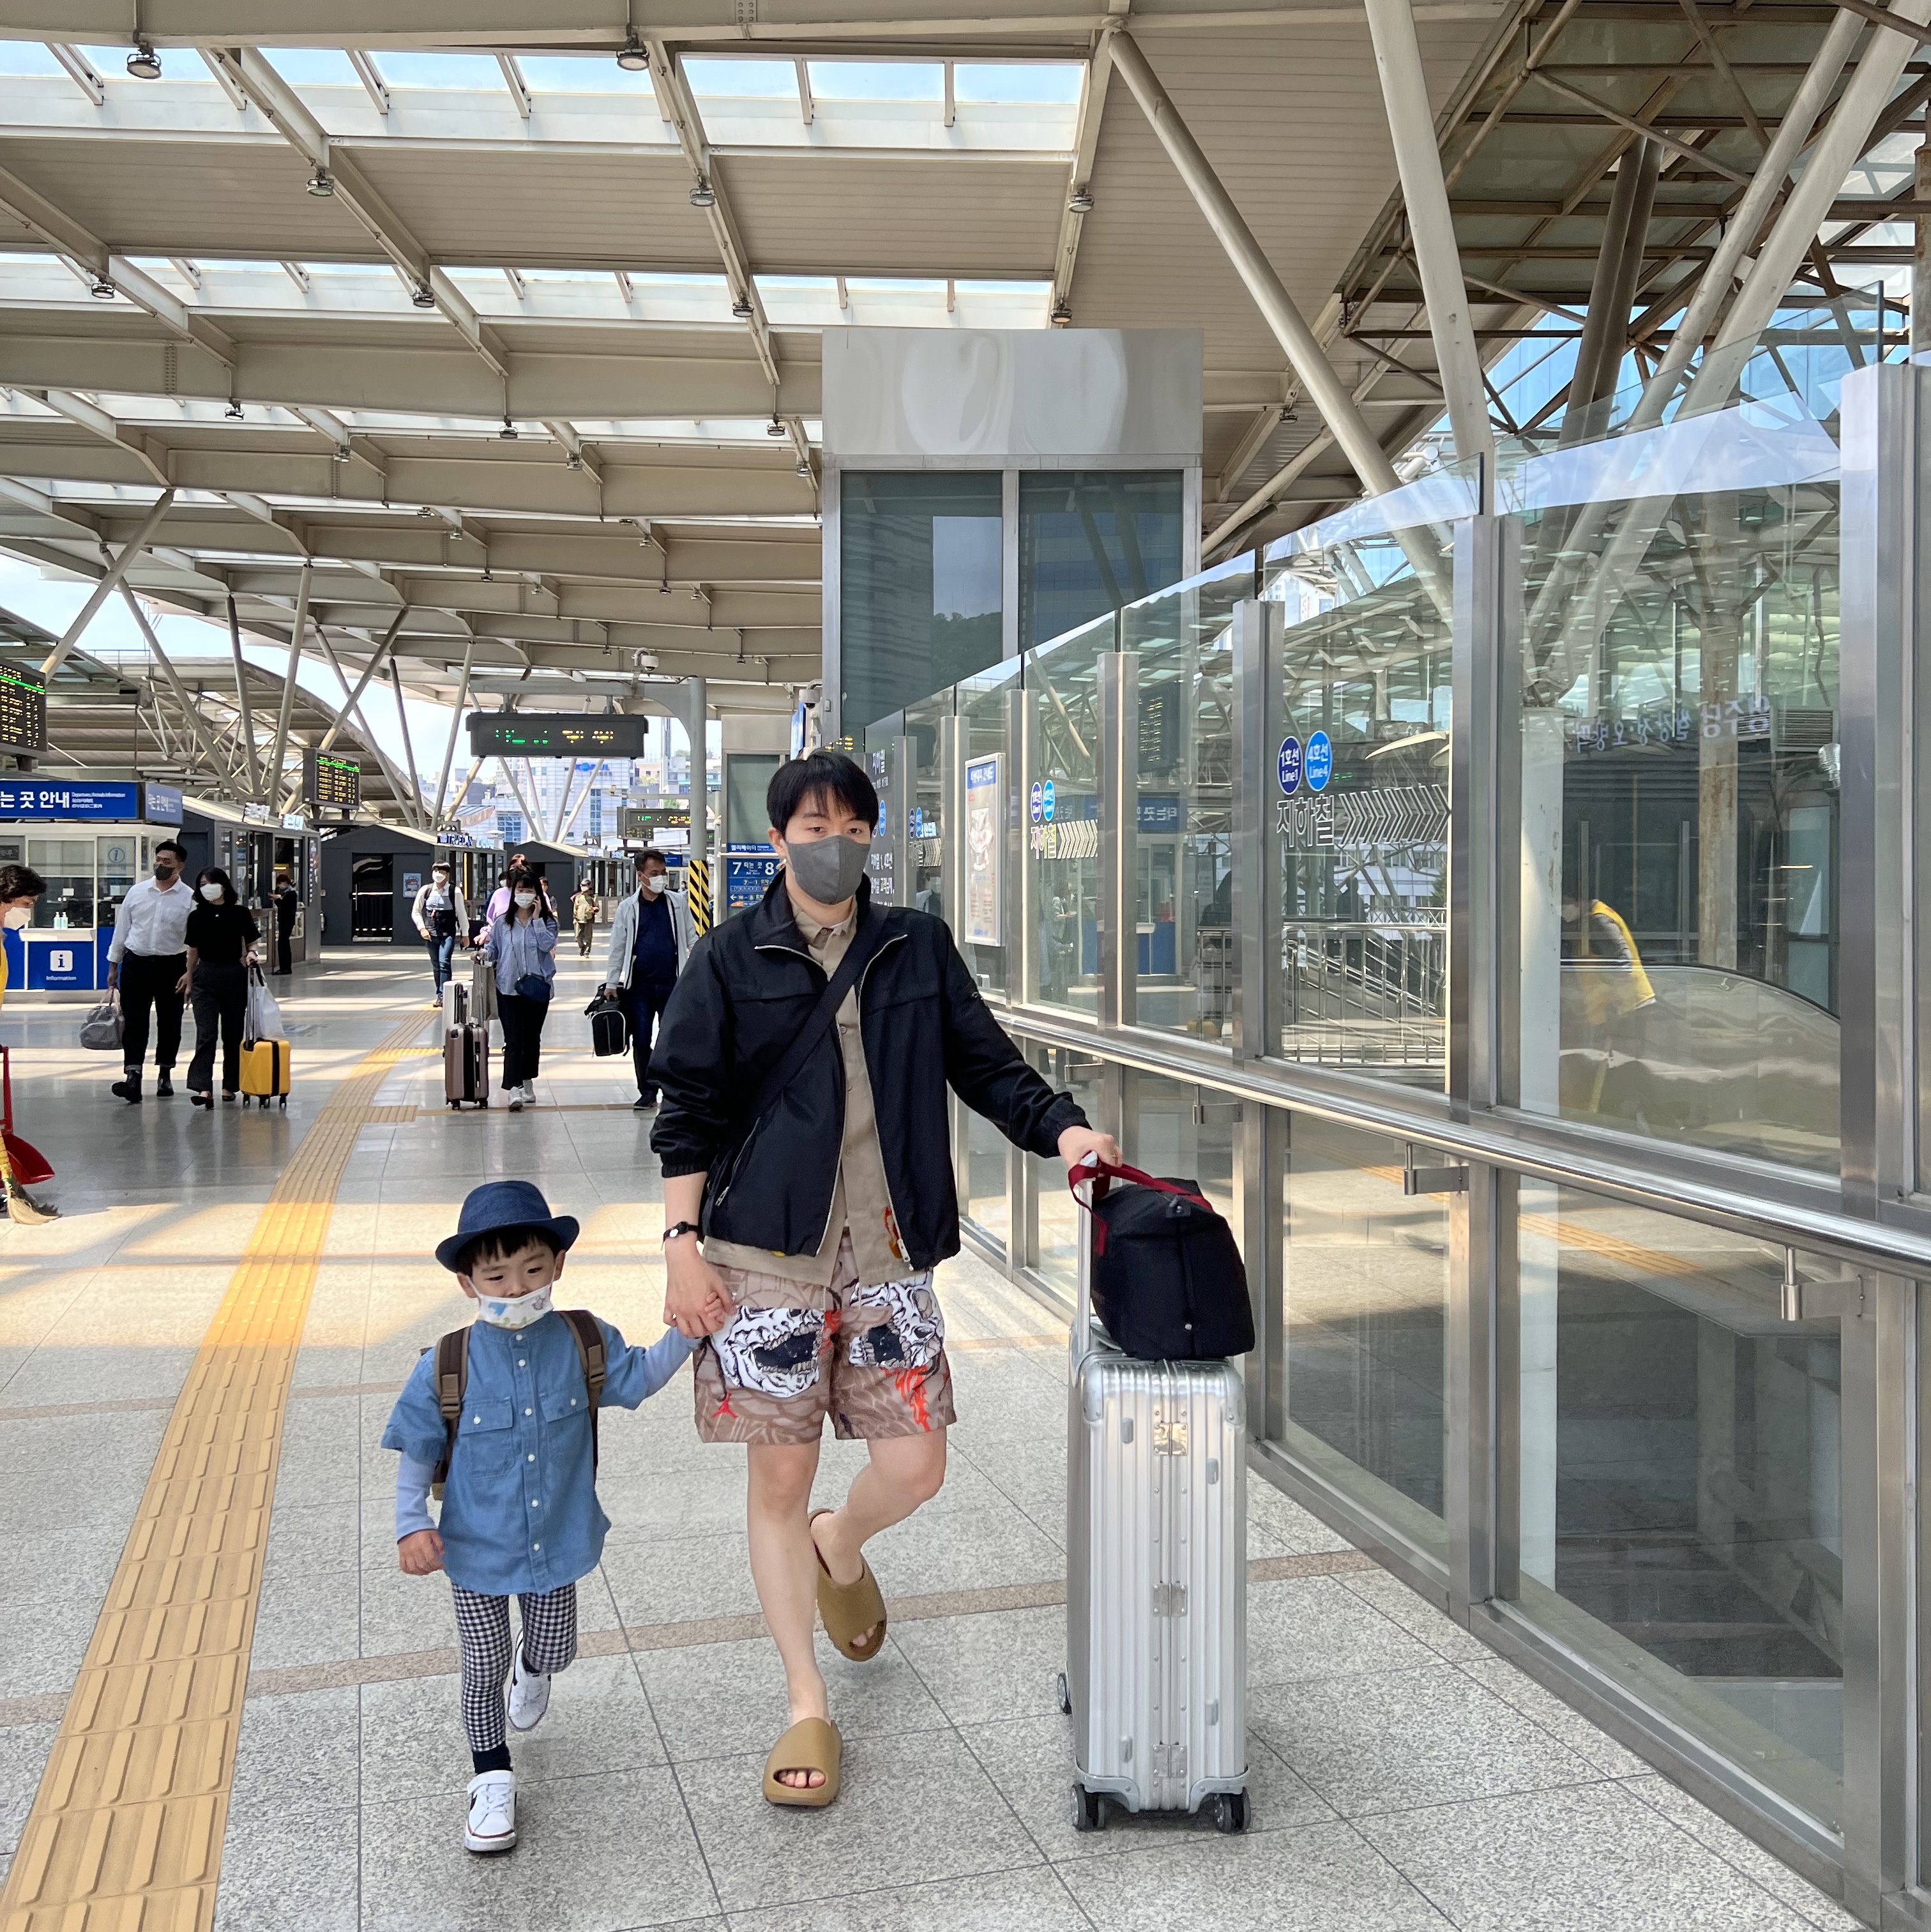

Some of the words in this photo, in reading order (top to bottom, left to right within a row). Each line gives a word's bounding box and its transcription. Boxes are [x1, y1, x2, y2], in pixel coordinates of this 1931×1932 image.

[1280, 748, 1299, 767] 1호선
[1307, 743, 1329, 762] 4호선
[1281, 768, 1299, 783] Line1
[19, 791, 35, 809] 곳
[39, 791, 70, 809] 안내
[1276, 793, 1335, 848] 지하철
[1030, 823, 1057, 860] 지하철
[732, 862, 742, 875] 7
[764, 862, 775, 875] 8
